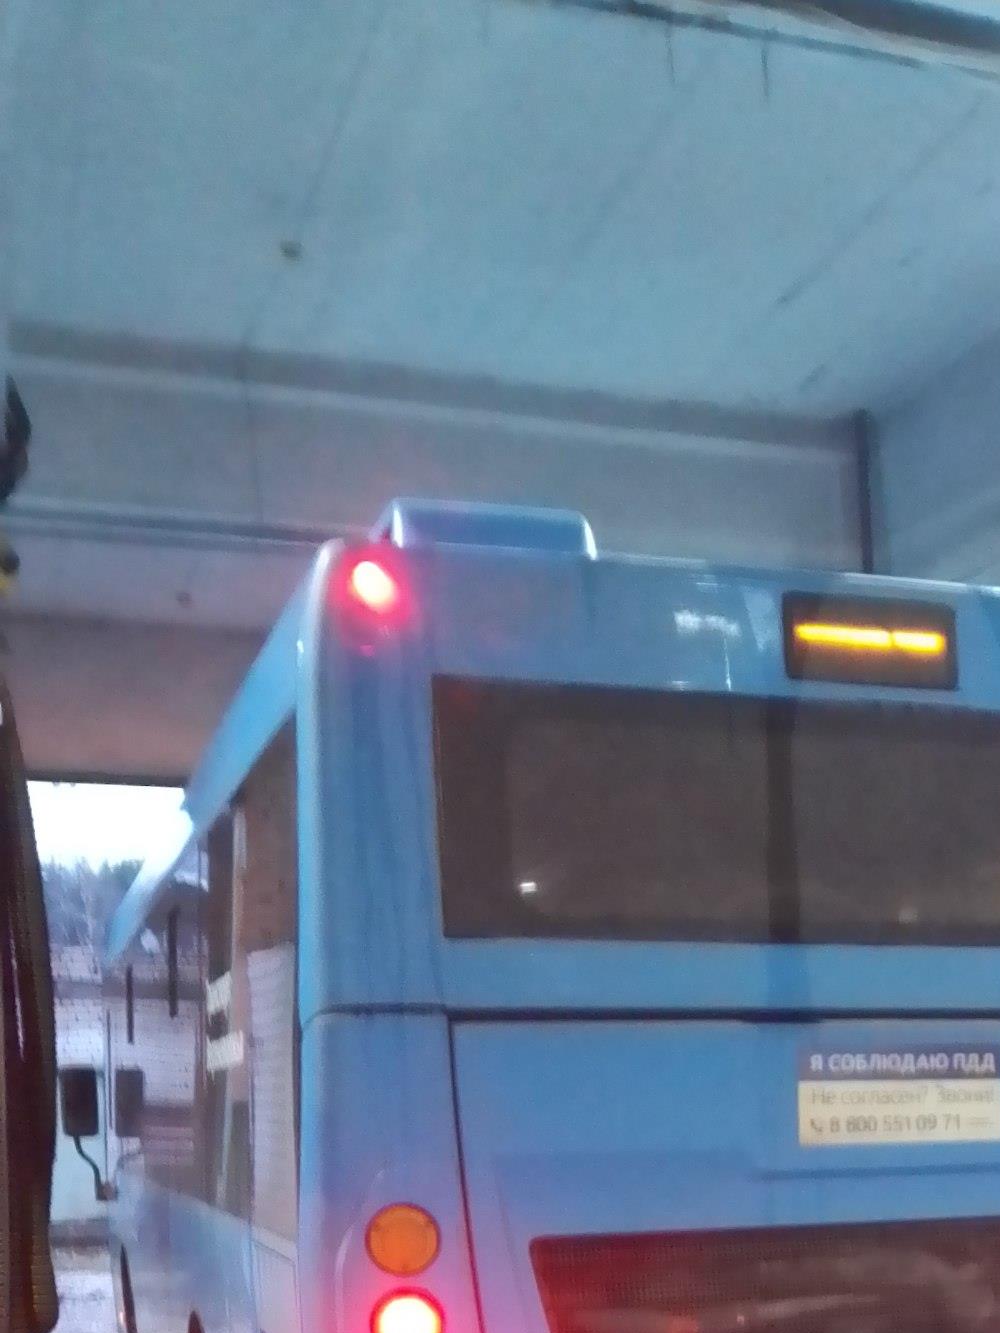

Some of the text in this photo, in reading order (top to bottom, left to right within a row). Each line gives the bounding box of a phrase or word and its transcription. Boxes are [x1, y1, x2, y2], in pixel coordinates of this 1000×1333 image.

[809, 1052, 996, 1073] Я СОБЛЮДАЮ ПДД
